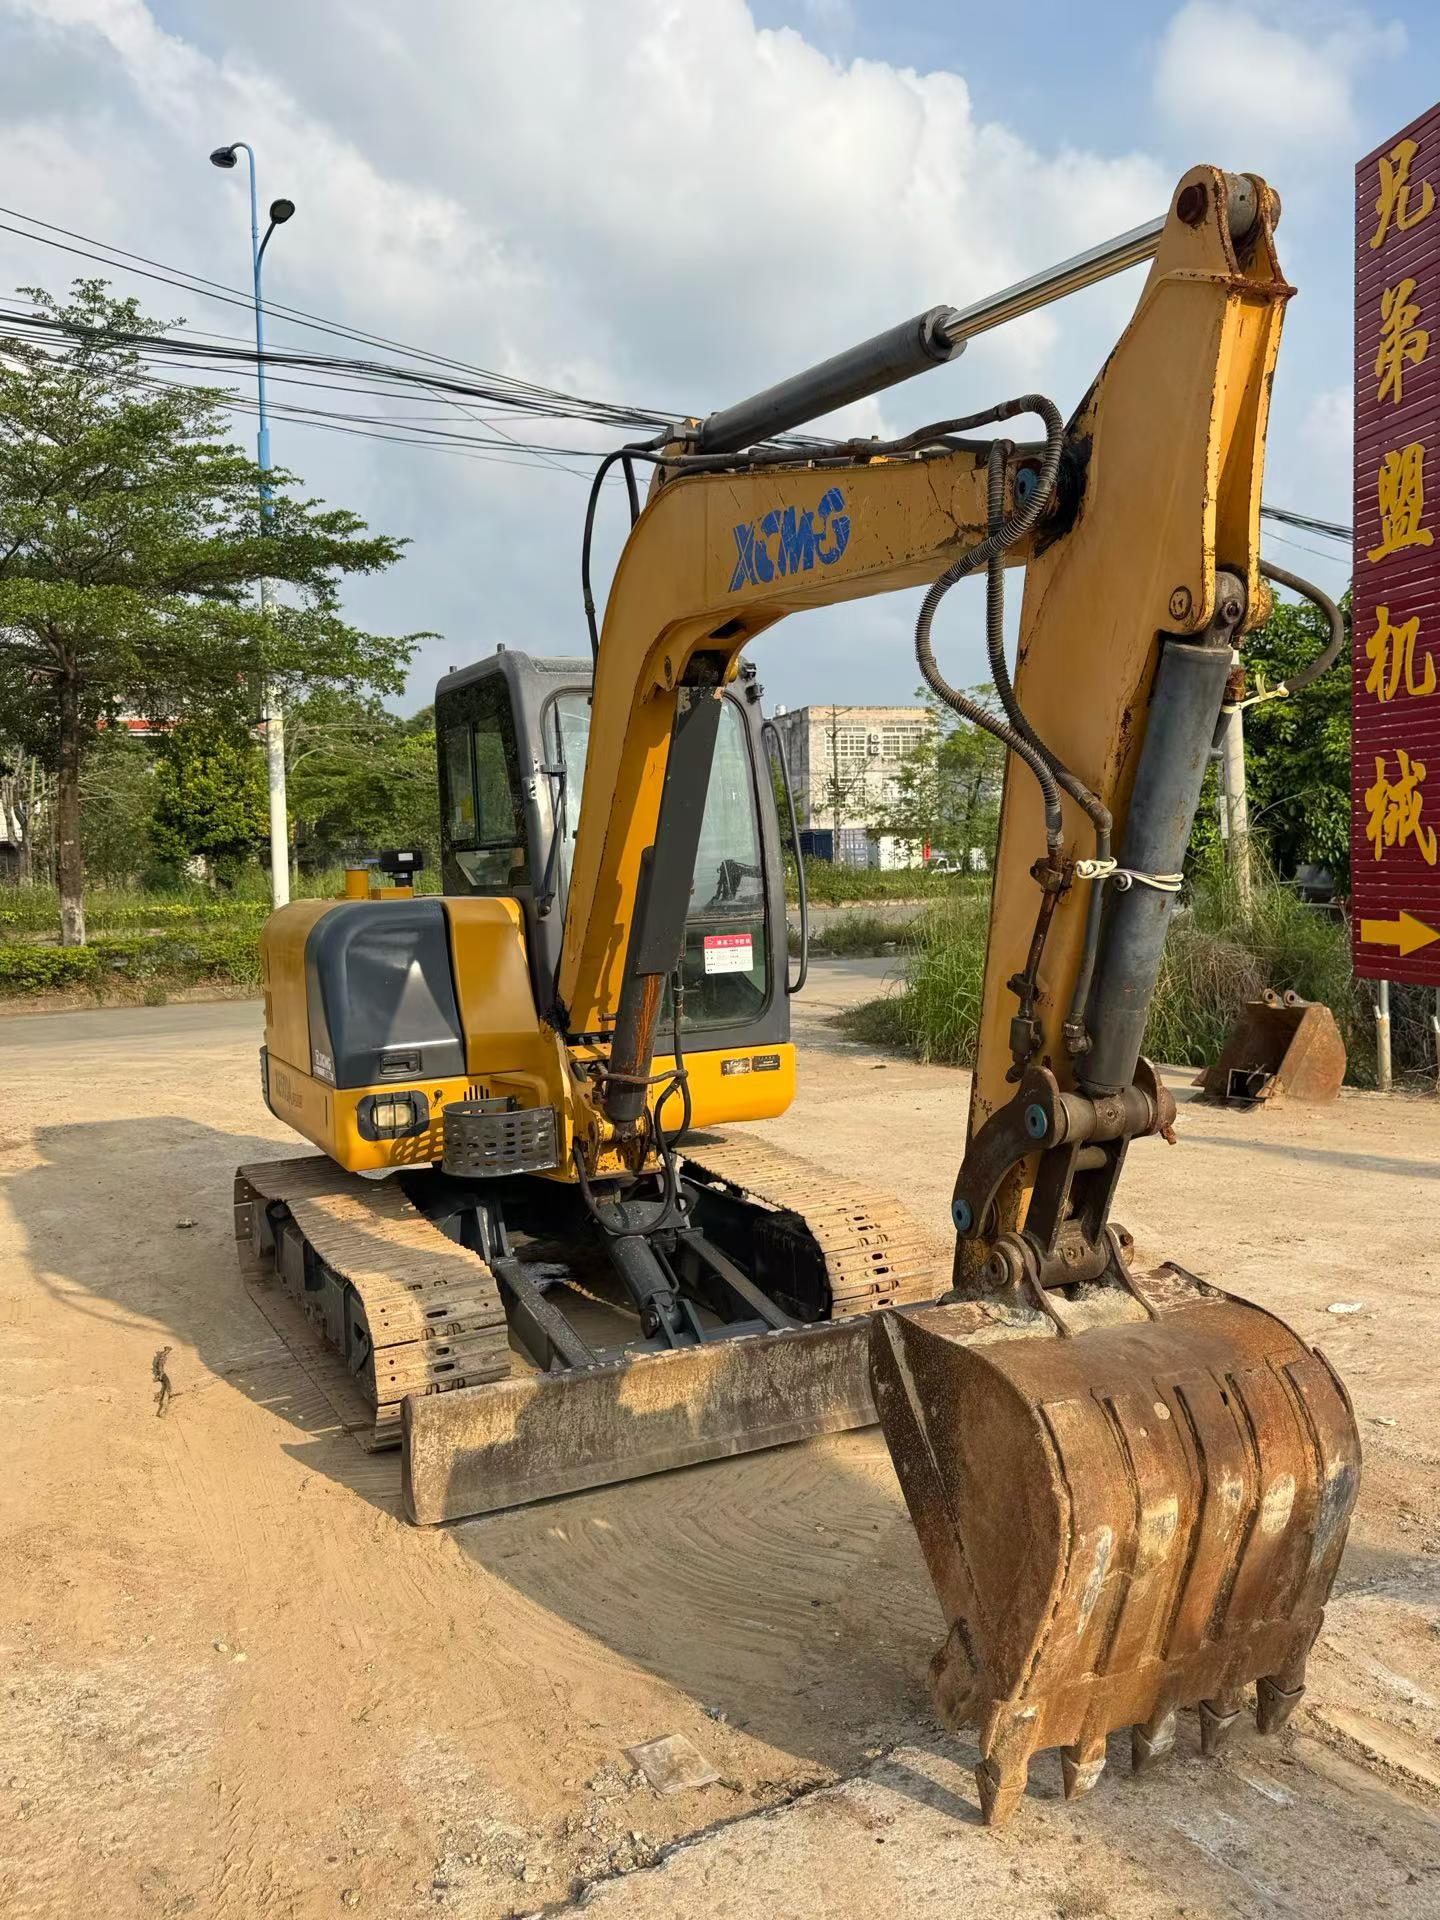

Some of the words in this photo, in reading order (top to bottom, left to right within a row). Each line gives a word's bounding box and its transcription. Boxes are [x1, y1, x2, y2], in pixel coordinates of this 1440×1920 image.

[1365, 139, 1437, 866] 兄弟盟机械
